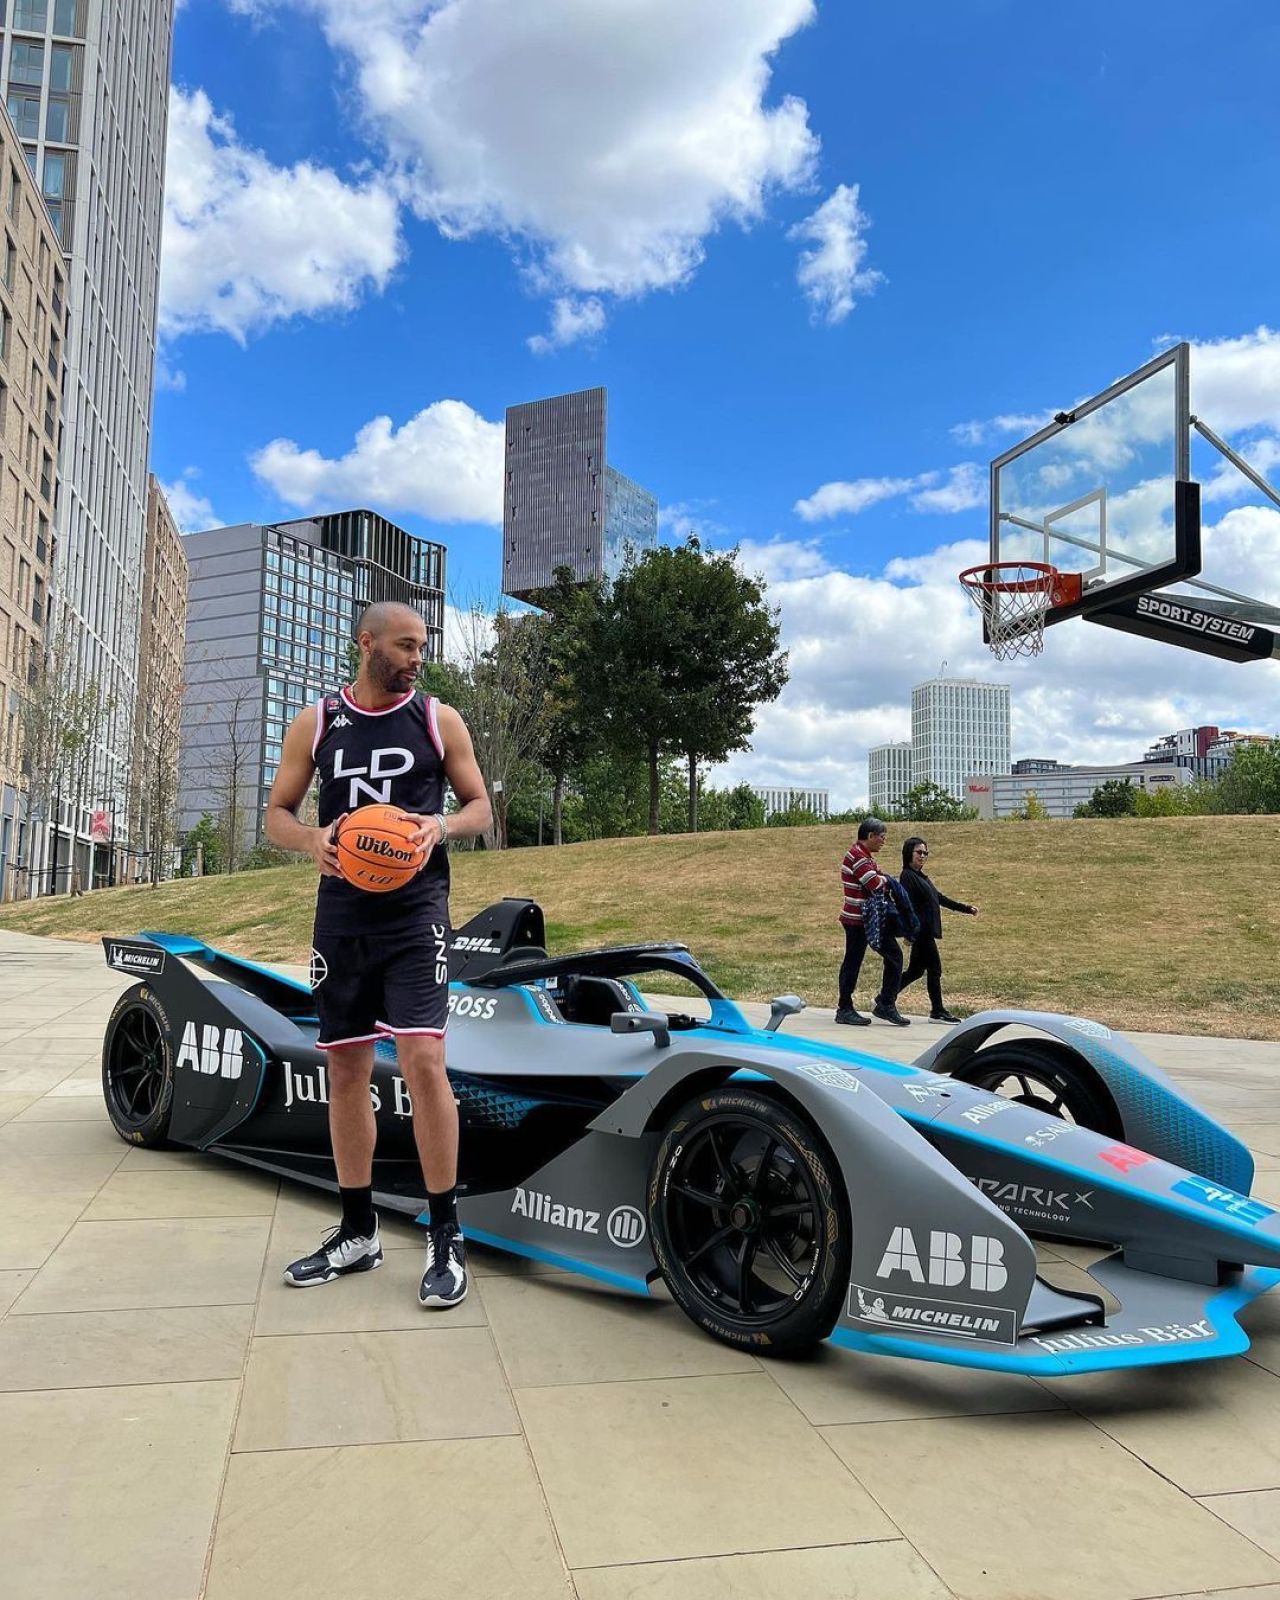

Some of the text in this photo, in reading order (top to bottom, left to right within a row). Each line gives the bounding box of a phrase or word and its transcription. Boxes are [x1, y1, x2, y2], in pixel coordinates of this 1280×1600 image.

[1138, 597, 1255, 640] SPORT SYSTEM
[333, 747, 415, 779] LD
[350, 777, 391, 808] N
[356, 834, 413, 862] Wilson
[123, 953, 160, 967] MICHELIN
[452, 936, 496, 953] DHL
[447, 995, 498, 1019] BOSS
[176, 1021, 243, 1079] ABB
[282, 1061, 382, 1111] Juls
[718, 1097, 769, 1113] MICHELIN
[511, 1187, 600, 1234] Allianz
[1014, 1208, 1070, 1221] TECHNOLOGY
[876, 1226, 1008, 1292] ABB
[891, 1305, 1000, 1332] MICHELIN
[1028, 1319, 1214, 1354] Julius Bär
